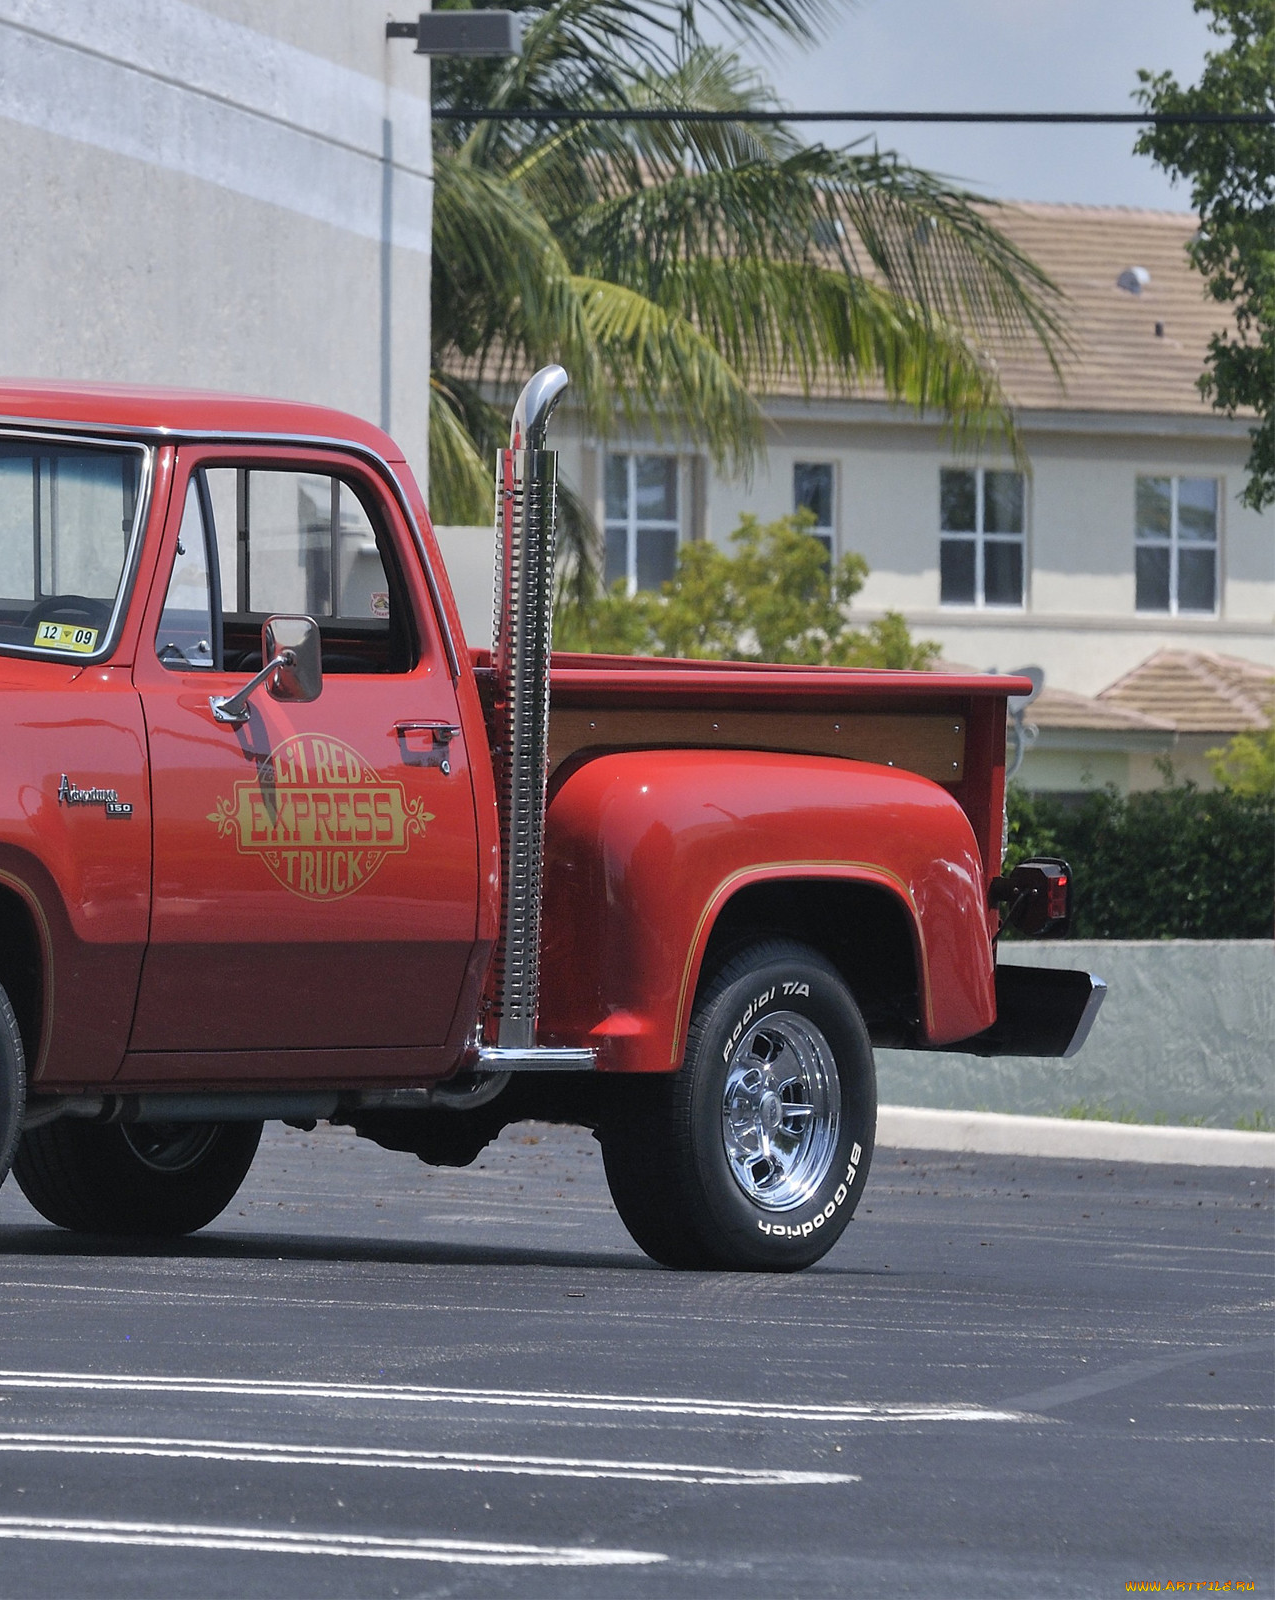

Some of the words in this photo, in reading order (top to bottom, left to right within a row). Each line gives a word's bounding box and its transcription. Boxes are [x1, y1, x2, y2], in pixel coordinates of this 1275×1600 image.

[43, 626, 58, 640] 12
[75, 629, 93, 645] 09
[311, 739, 362, 784] RED
[109, 804, 131, 812] 150
[248, 792, 395, 844] EXPRESS
[281, 851, 364, 895] TRUCK
[723, 986, 776, 1064] Radial
[782, 981, 810, 998] T/A
[757, 1142, 863, 1240] BFGoodrich
